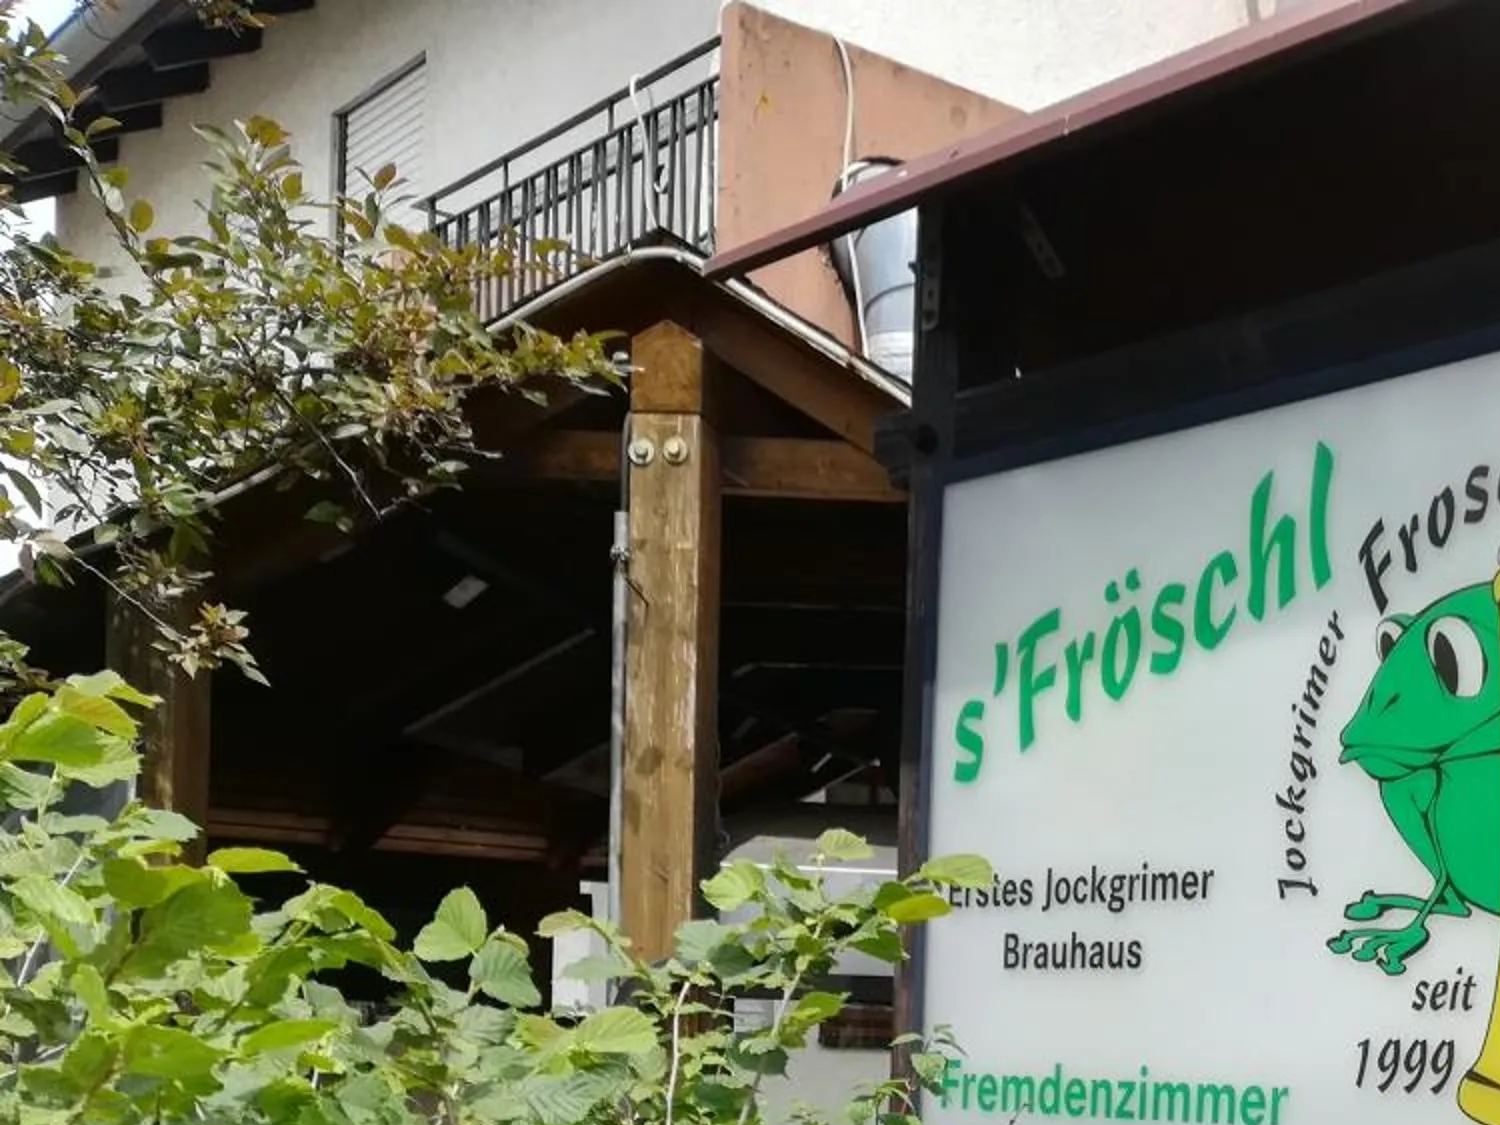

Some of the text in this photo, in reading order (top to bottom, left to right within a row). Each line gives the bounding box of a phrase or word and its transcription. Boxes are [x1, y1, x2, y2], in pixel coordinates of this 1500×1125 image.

[1275, 610, 1345, 900] Jockgrimer
[1041, 862, 1215, 914] Jockgrimer
[1003, 931, 1143, 970] Brauhaus
[1411, 967, 1477, 1012] seit
[1355, 1037, 1456, 1095] 1999
